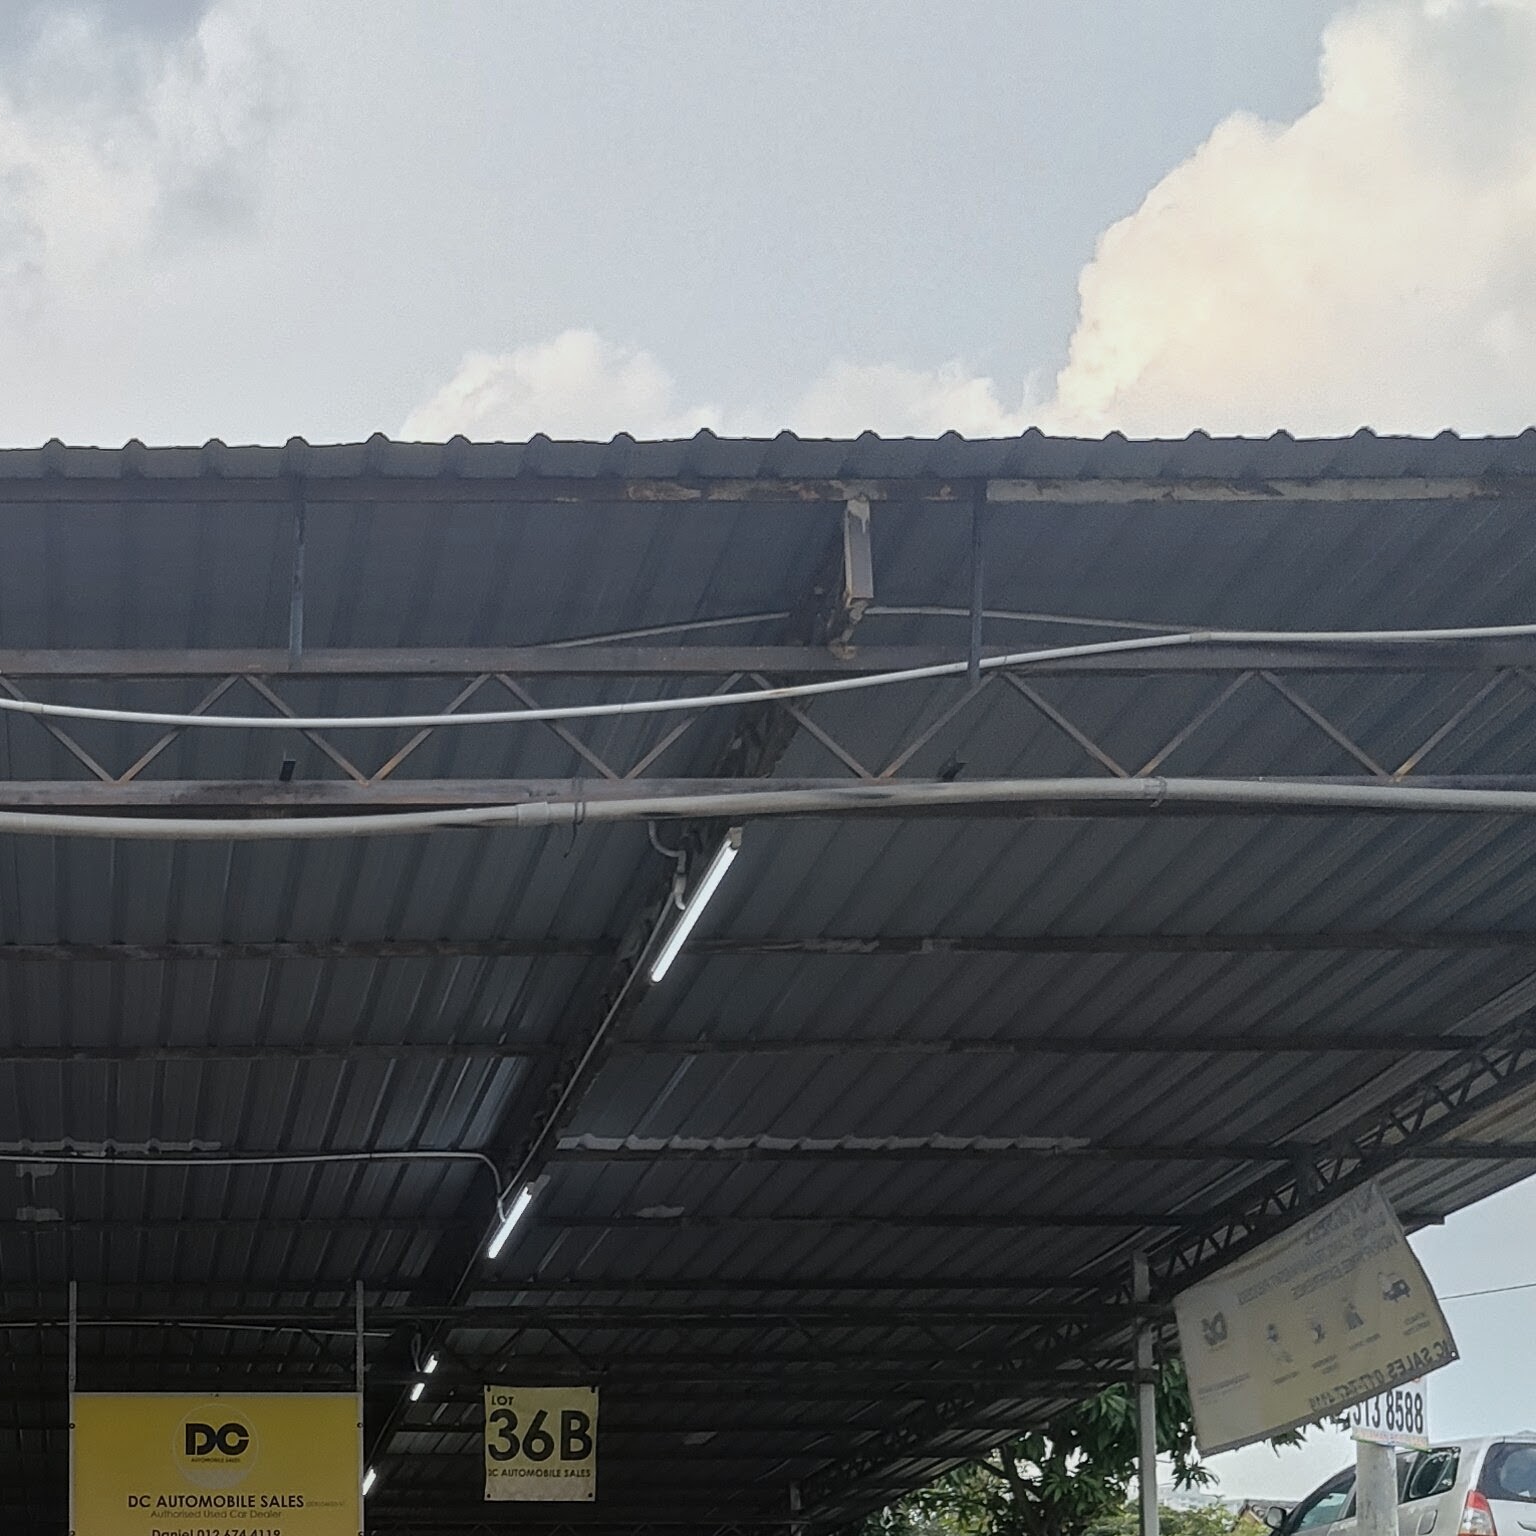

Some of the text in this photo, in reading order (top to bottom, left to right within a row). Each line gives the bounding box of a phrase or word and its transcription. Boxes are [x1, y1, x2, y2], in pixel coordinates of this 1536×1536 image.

[491, 1395, 514, 1406] LOT
[1386, 1389, 1424, 1435] 8588
[185, 1422, 250, 1456] DC
[488, 1408, 593, 1462] 36B
[501, 1469, 561, 1478] AUTOMOBILE
[564, 1469, 591, 1478] SALES
[128, 1495, 151, 1508] DC
[156, 1495, 256, 1508] AUTOMOBILE
[260, 1495, 304, 1508] SALES
[204, 1510, 227, 1519] Used
[229, 1510, 248, 1519] Car
[250, 1510, 282, 1519] Dealer
